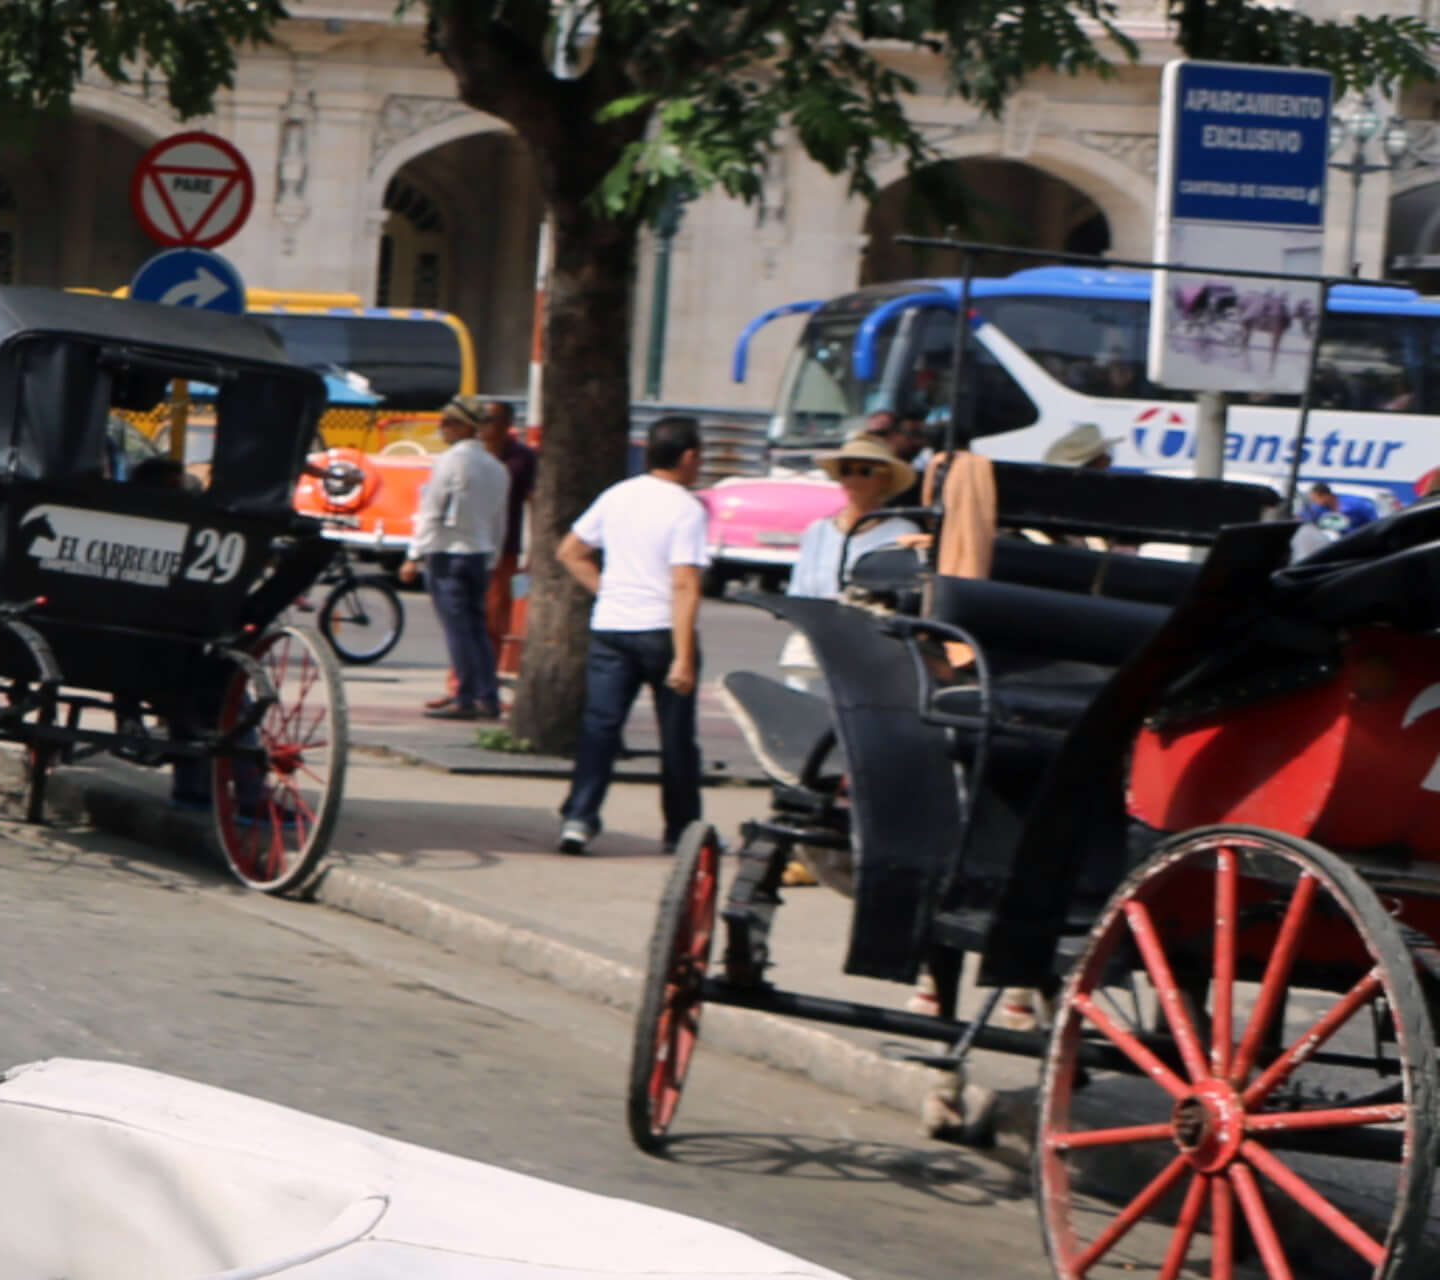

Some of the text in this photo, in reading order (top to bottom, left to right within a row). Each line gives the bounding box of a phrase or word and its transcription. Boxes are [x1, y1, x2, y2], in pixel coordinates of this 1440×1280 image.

[1184, 88, 1324, 119] APARCAMIENTO
[1201, 124, 1303, 153] EXCLUSIVO
[173, 176, 212, 195] PARE
[57, 535, 80, 561] EL
[184, 528, 246, 585] 29
